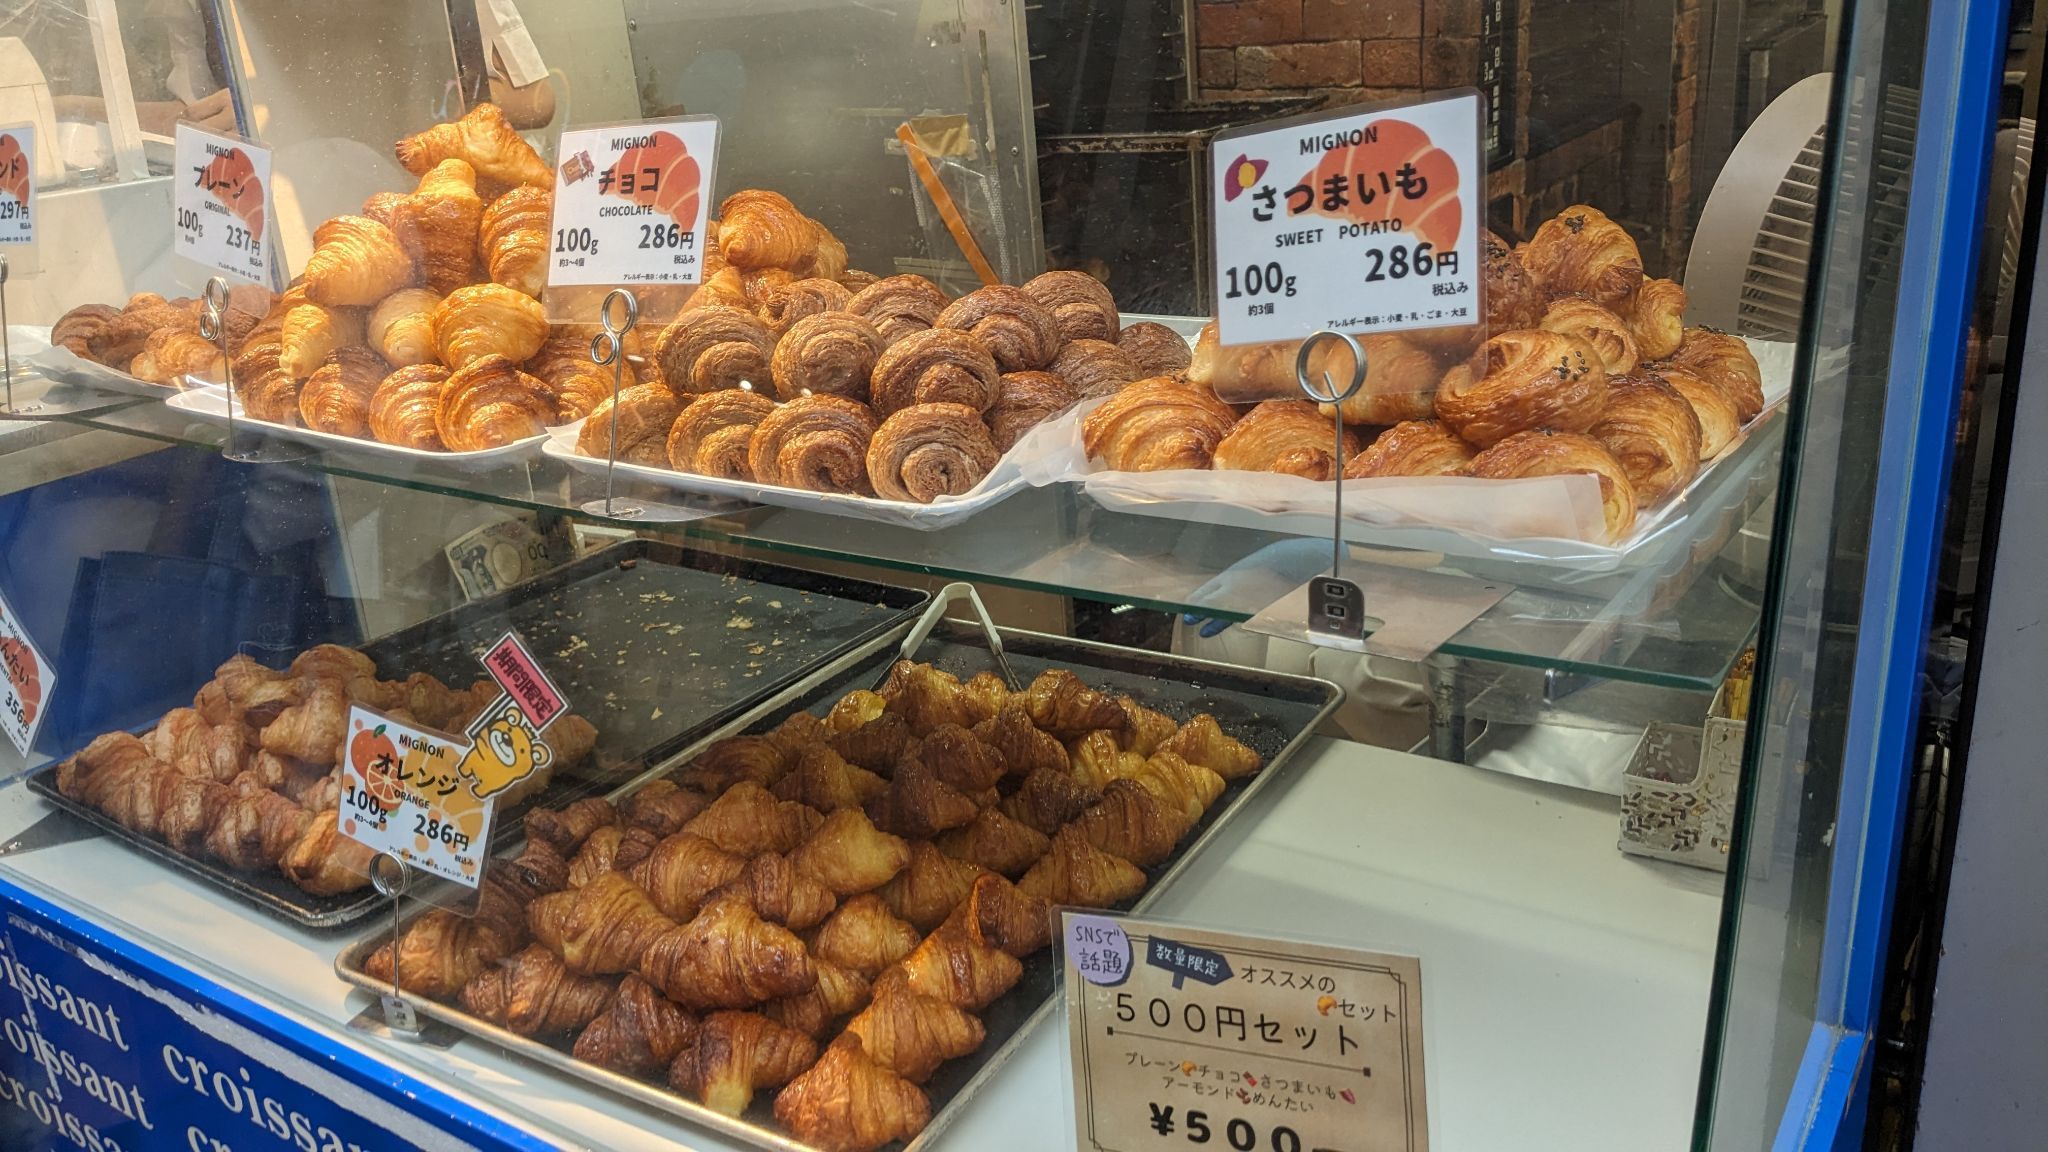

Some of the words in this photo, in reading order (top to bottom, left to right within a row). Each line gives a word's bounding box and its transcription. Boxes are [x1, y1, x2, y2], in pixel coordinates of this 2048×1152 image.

[206, 143, 235, 160] MIGNON
[611, 135, 658, 151] MIGNON
[1299, 125, 1378, 155] MIGNON
[193, 165, 245, 199] プレーン
[598, 167, 660, 196] チョコ
[1252, 162, 1428, 222] さつまいも
[0, 200, 29, 219] 297円
[177, 206, 203, 238] 100g
[599, 204, 653, 217] CHOCOLATE
[226, 224, 260, 256] 237円
[555, 227, 598, 255] 100g
[638, 223, 694, 250] 286円
[1275, 228, 1324, 248] SWEET
[1339, 217, 1402, 240] POTATO
[673, 254, 695, 264] 税込み
[1364, 242, 1459, 283] 286円
[1224, 260, 1297, 299] 100g
[1431, 282, 1469, 297] 税込み
[1247, 302, 1275, 317] 約3個
[7, 621, 29, 655] MIGNON
[492, 646, 554, 721] 期間限定
[5, 691, 30, 734] 356円
[398, 733, 445, 759] MIGNON
[374, 752, 460, 796] オレンジ
[346, 785, 389, 824] 100g
[394, 789, 430, 810] ORANGE
[413, 813, 470, 852] 286円
[1074, 924, 1120, 946] SNSで
[1078, 950, 1124, 975] 話題
[1156, 943, 1220, 978] 数量限定
[0, 938, 130, 1052] issant
[1240, 965, 1336, 994] オススメの
[1116, 992, 1359, 1057] 500円セット
[1338, 998, 1397, 1025] セット
[0, 1013, 154, 1131] oissant
[1125, 1051, 1182, 1074] プレーン
[1198, 1064, 1241, 1085] チョコ
[1260, 1073, 1337, 1101] さつまいも
[1162, 1076, 1237, 1101] アーモンド
[1252, 1091, 1314, 1113] めんたい
